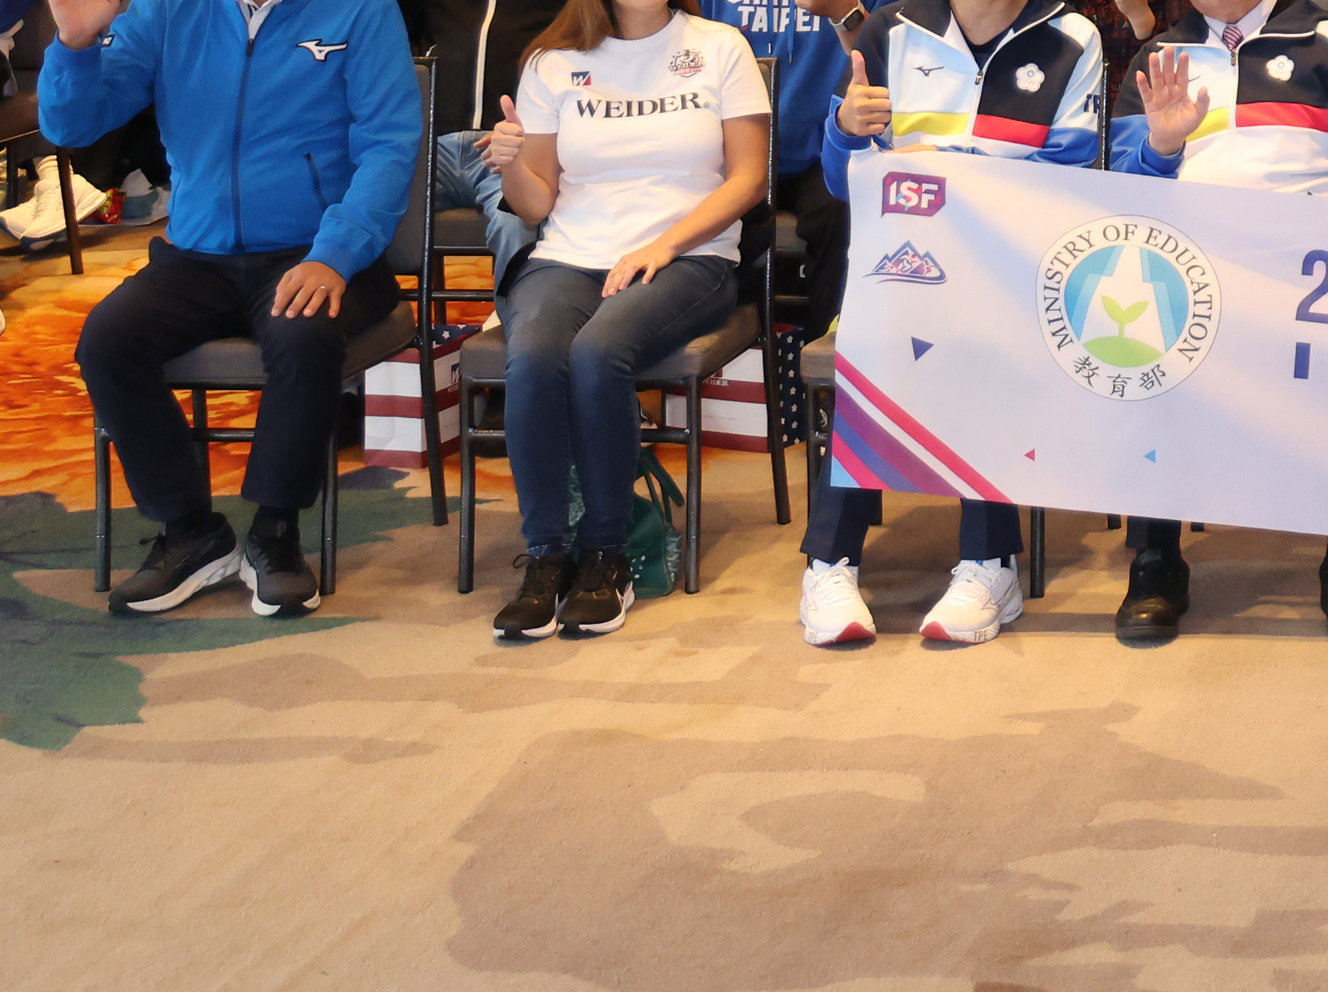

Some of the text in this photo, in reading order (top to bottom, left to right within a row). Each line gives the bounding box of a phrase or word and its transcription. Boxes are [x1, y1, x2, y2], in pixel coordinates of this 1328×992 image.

[576, 92, 702, 119] WEIDER
[888, 179, 940, 209] ISF
[1042, 222, 1213, 363] MINISTRY OF EDUCATION
[1072, 355, 1167, 399] 教育部
